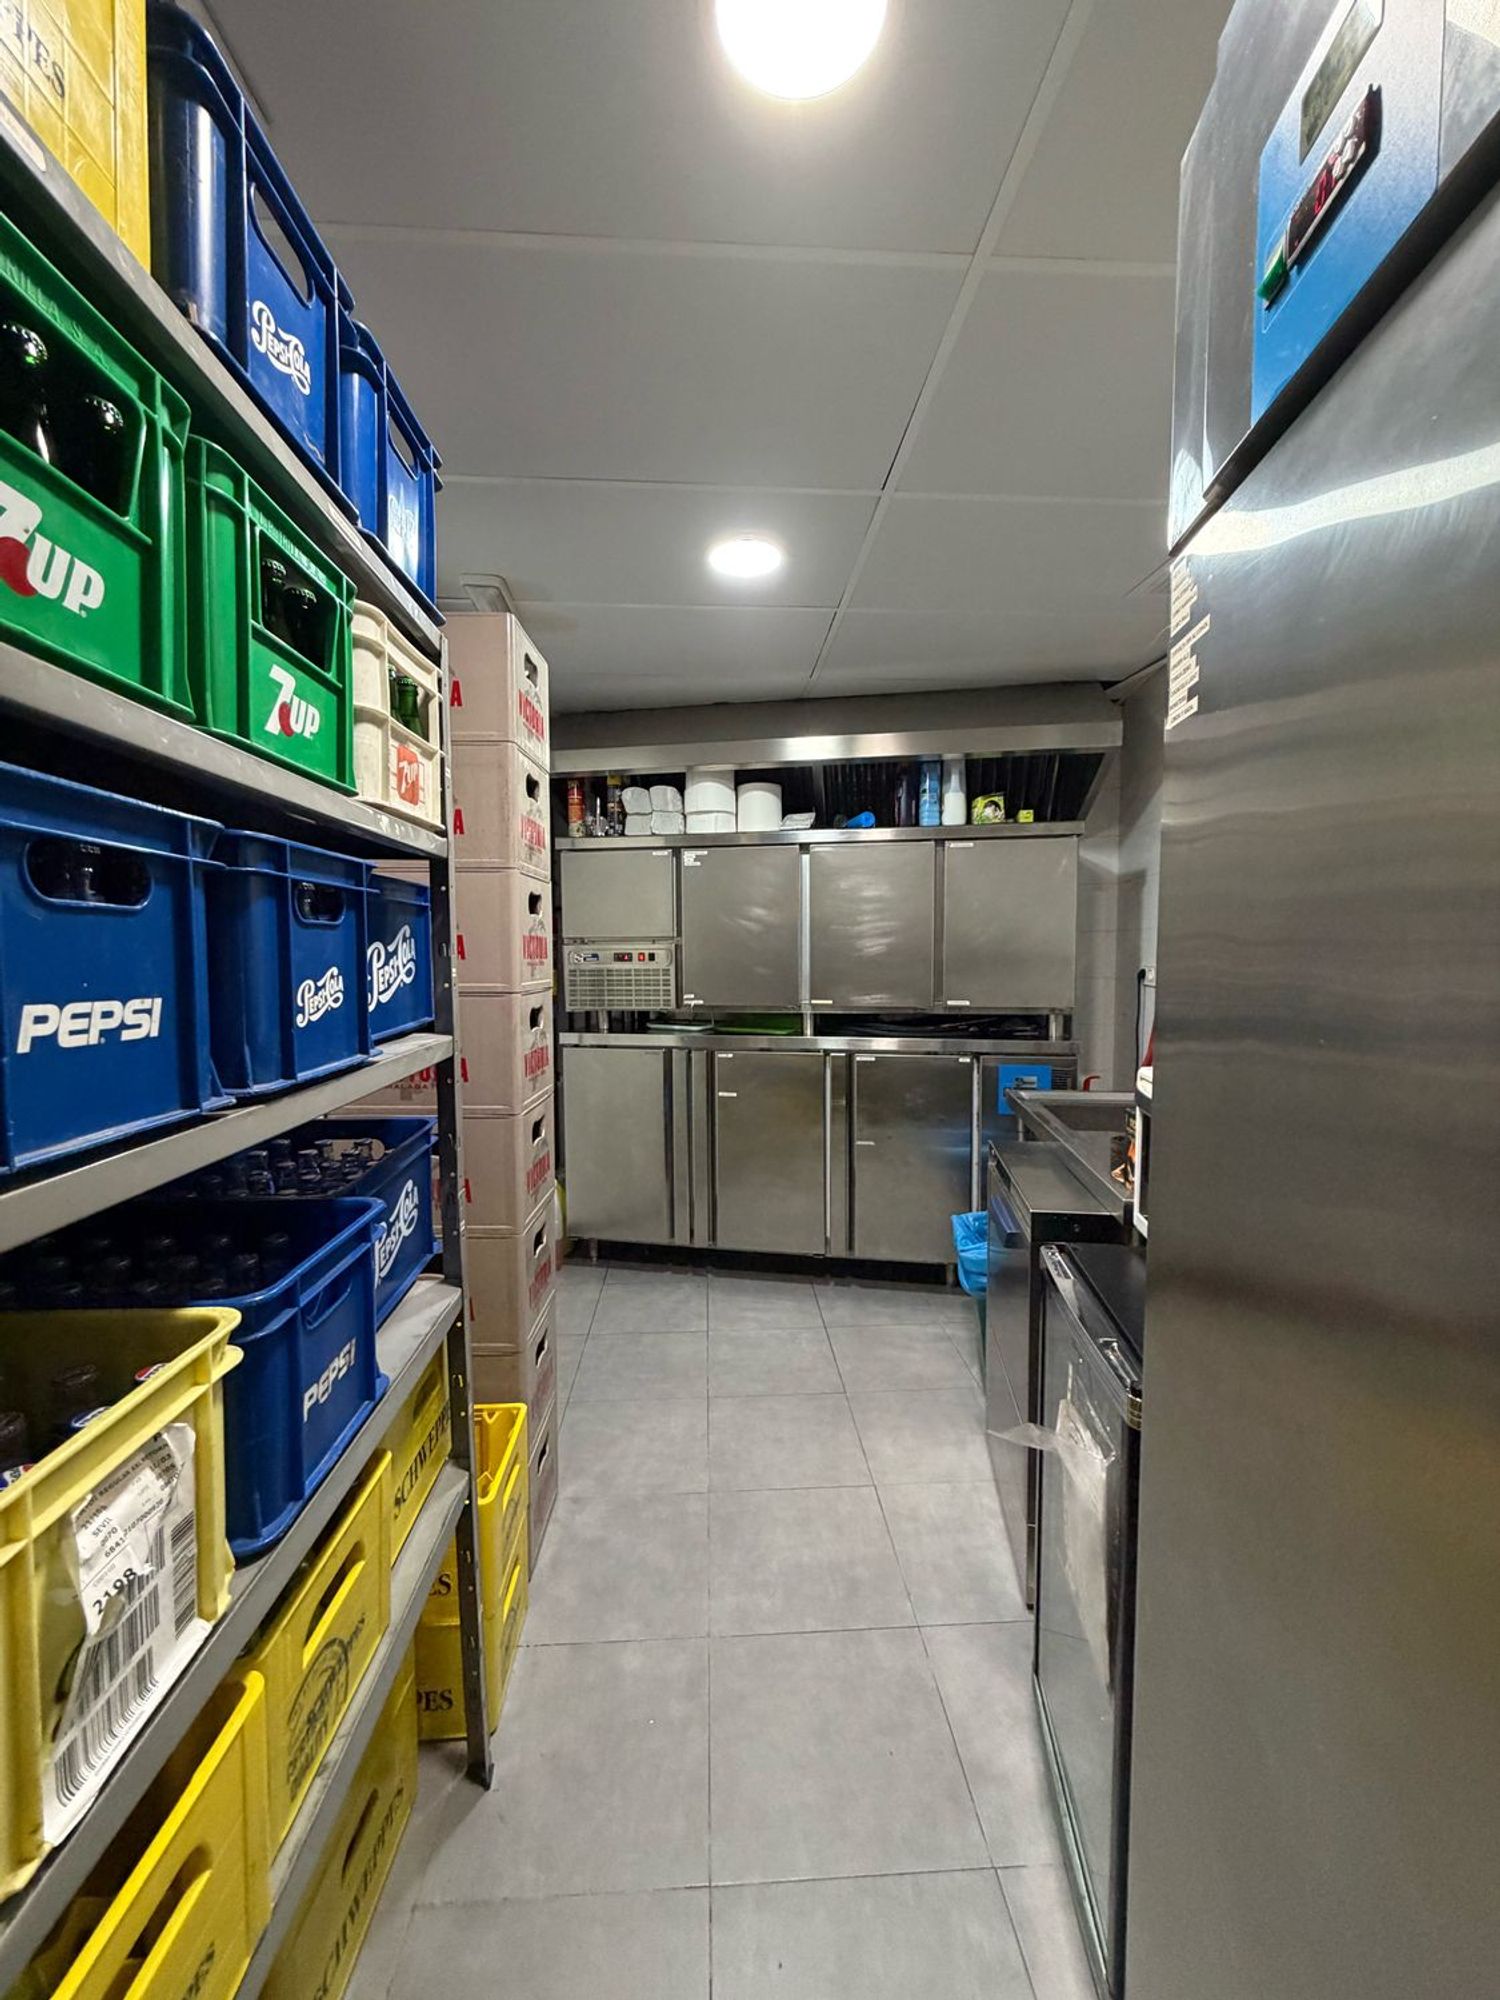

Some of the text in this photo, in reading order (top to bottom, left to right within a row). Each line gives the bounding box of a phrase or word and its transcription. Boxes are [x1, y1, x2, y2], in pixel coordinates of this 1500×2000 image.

[264, 664, 320, 739] 7UP
[16, 997, 163, 1055] PEPSI
[303, 1337, 356, 1424] PEPSI
